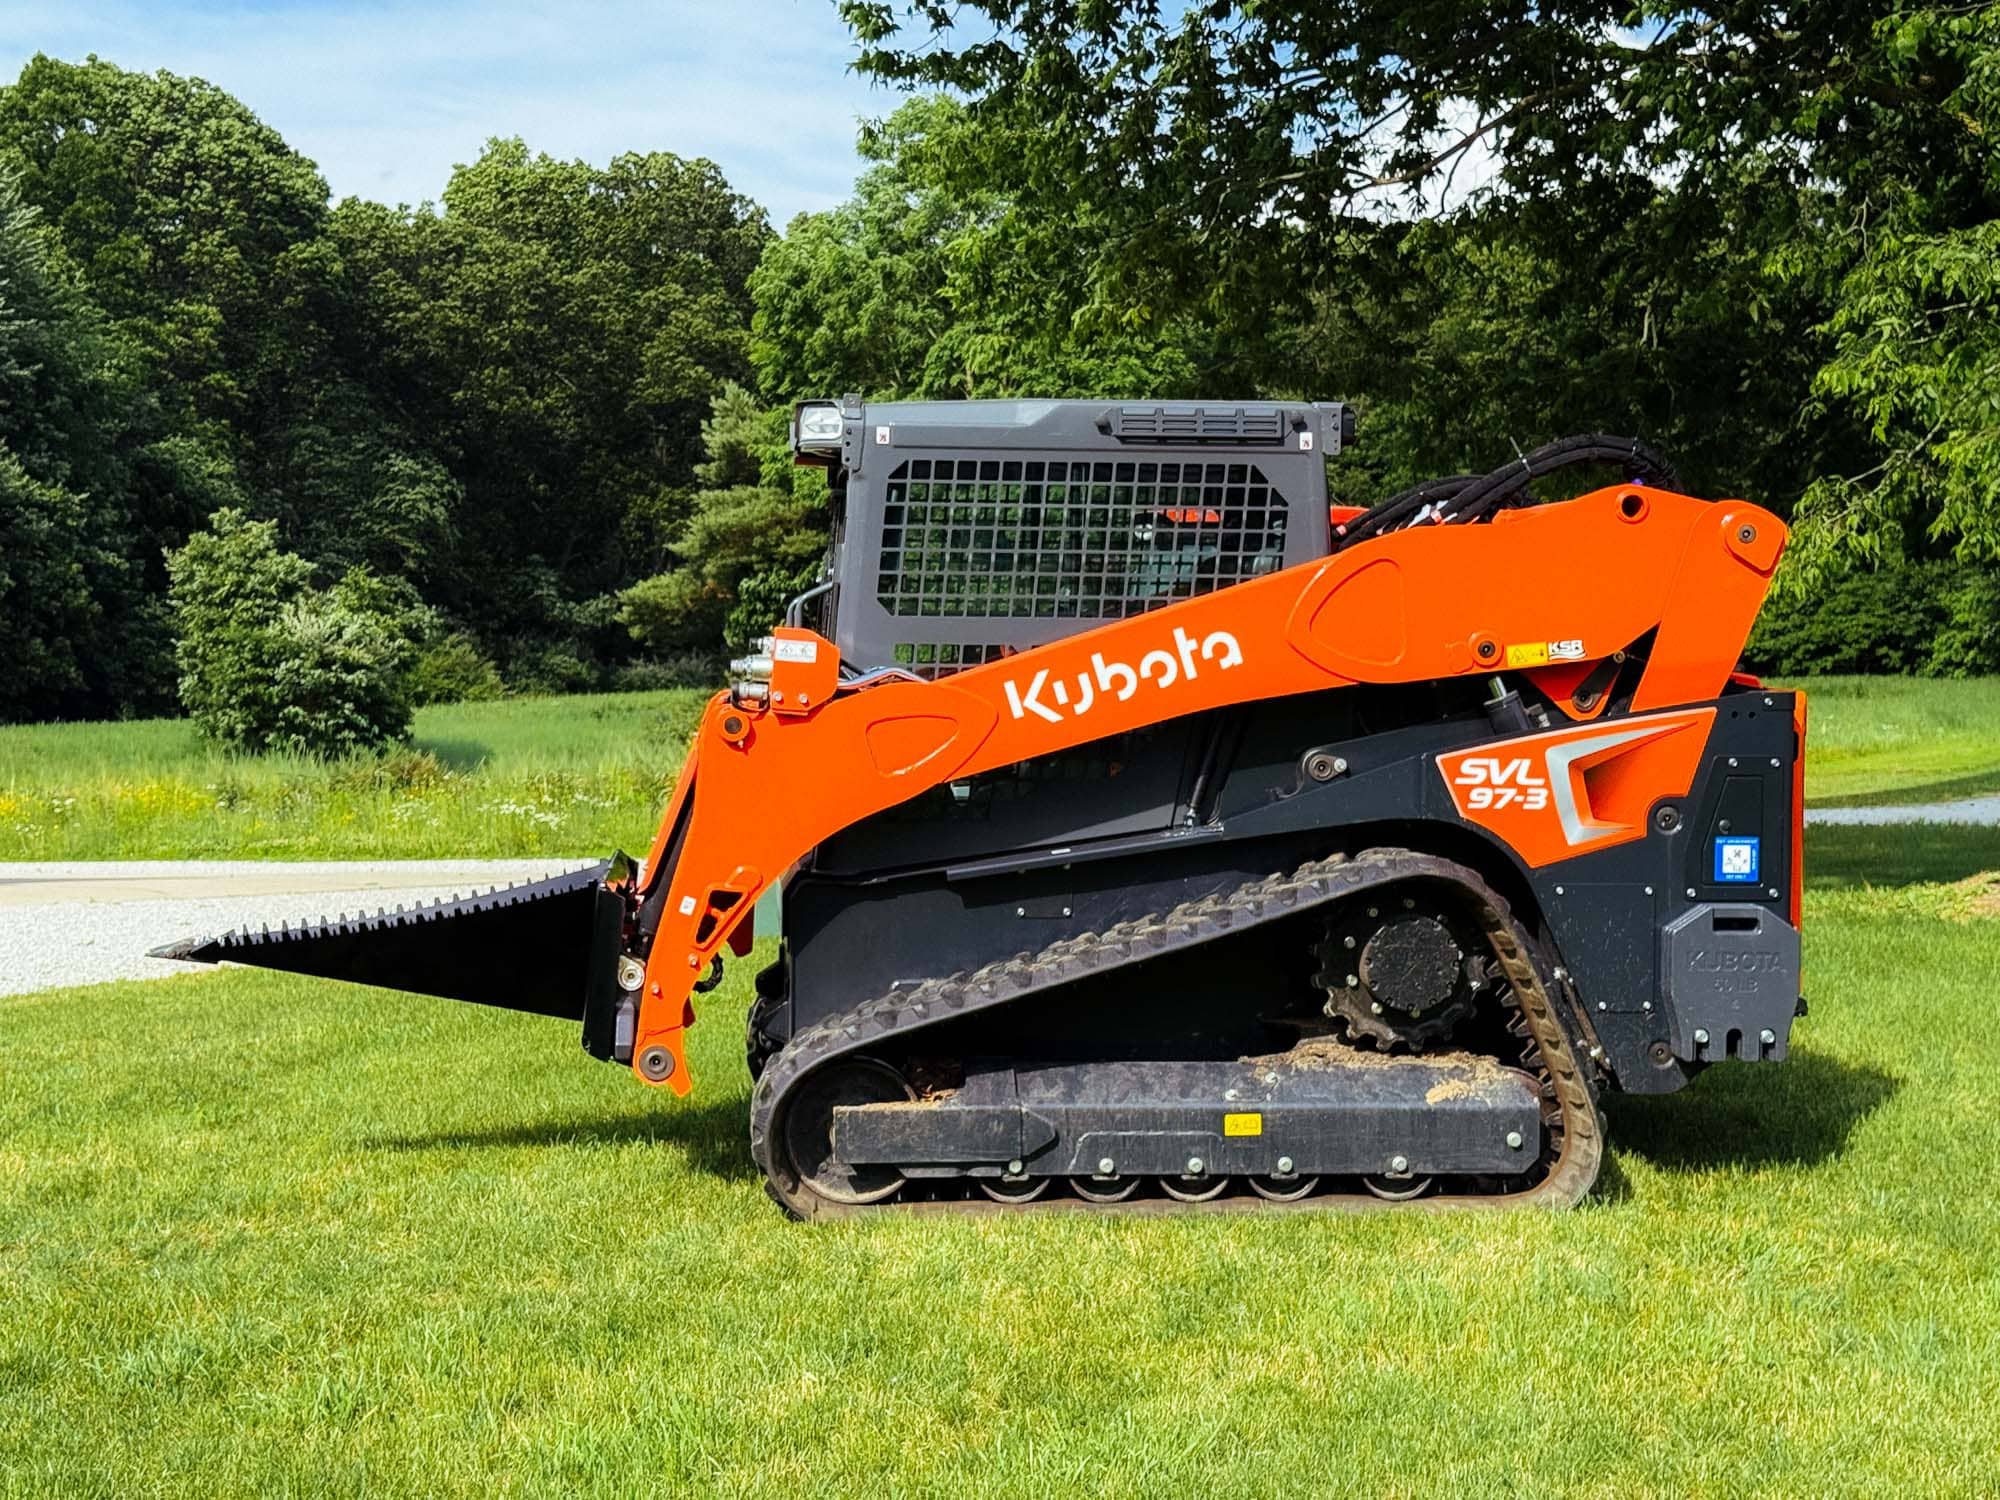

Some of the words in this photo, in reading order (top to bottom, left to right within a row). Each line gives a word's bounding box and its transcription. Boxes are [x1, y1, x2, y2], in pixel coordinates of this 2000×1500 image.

[1003, 627, 1244, 723] Kubota
[1454, 758, 1545, 785] SVL
[1467, 787, 1548, 810] 97-3
[1687, 951, 1787, 973] KUBOTA
